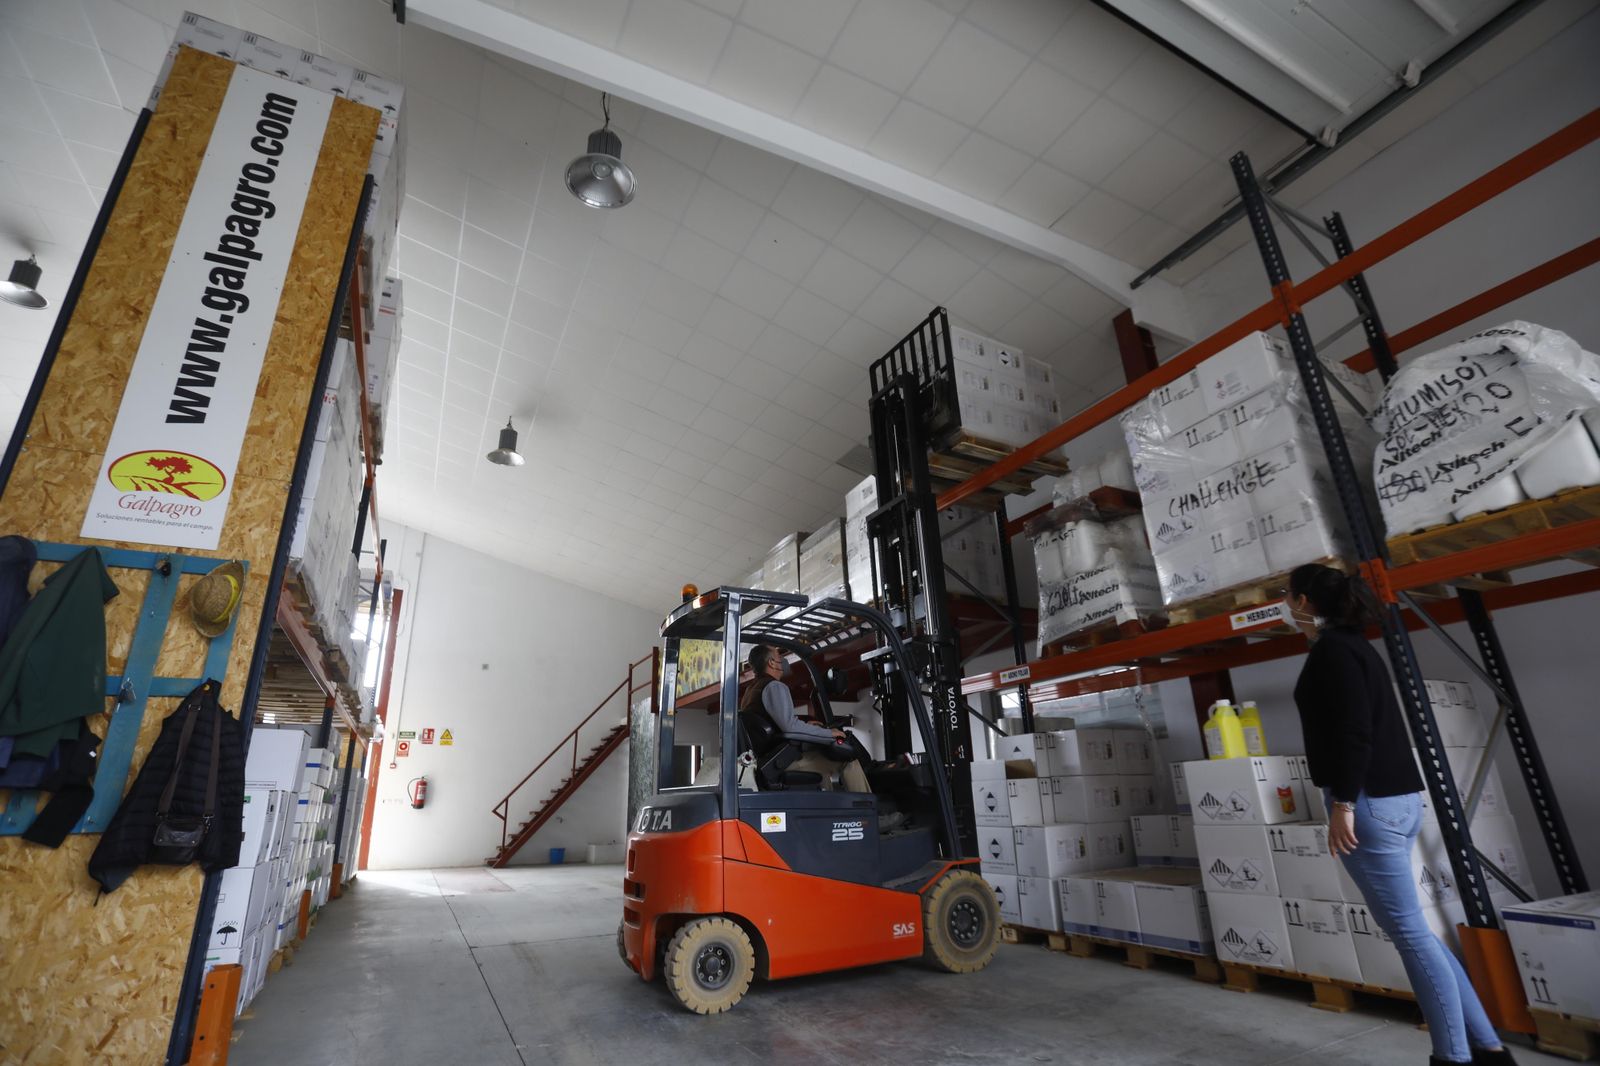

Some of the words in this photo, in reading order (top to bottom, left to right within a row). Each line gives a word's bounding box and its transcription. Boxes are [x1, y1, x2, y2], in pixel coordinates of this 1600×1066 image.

[165, 92, 298, 423] www.galpagro.com
[1169, 463, 1276, 518] CHALLENGE
[118, 494, 202, 519] Galpagro
[96, 512, 133, 522] Soluciones
[134, 517, 166, 526] rentables
[166, 520, 183, 528] para
[948, 686, 959, 731] TOYOTA
[832, 828, 864, 841] 25
[892, 922, 915, 936] SAS
